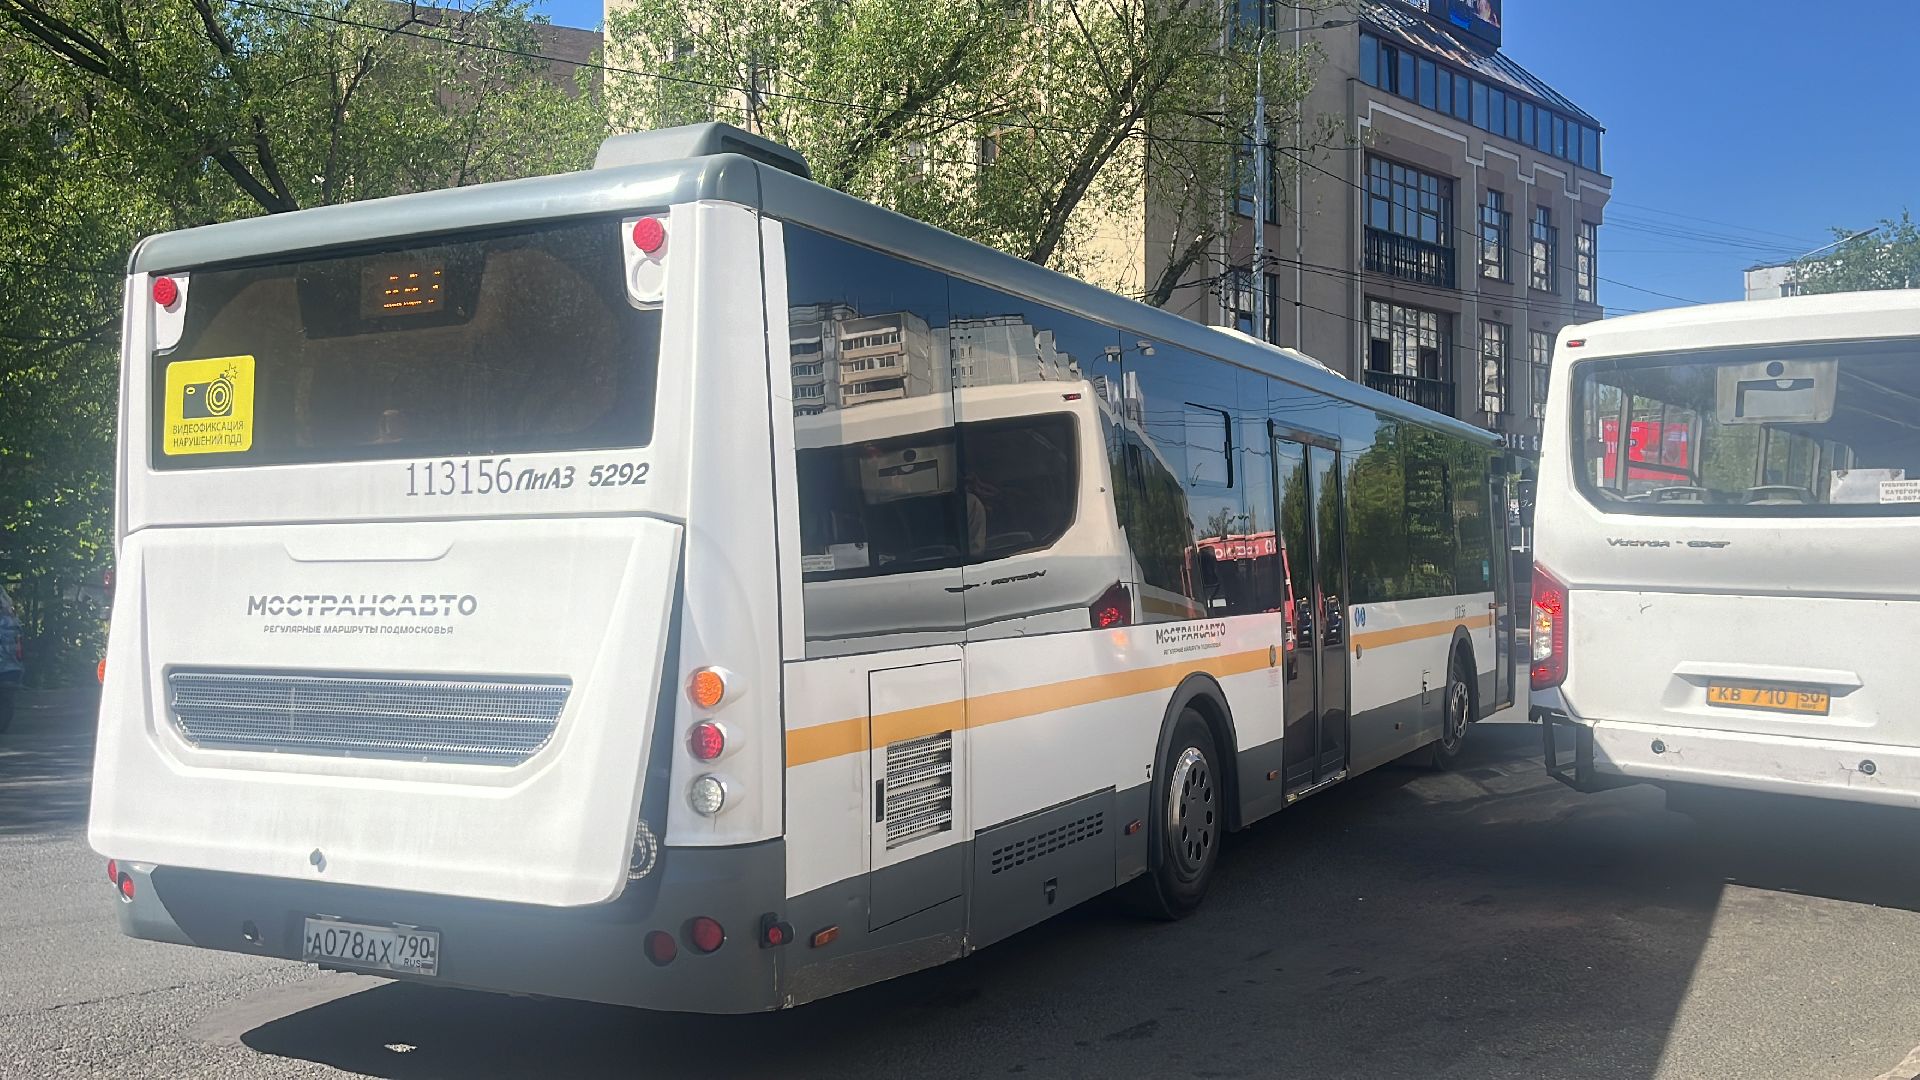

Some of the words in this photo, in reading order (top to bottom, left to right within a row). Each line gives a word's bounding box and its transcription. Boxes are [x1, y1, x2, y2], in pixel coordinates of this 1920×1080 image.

[173, 421, 243, 435] ВИДЕОФИКСАЦИЯ
[173, 434, 223, 447] НАРУШЕНИЙ
[225, 434, 242, 446] ПДД
[406, 458, 513, 496] 113156
[516, 465, 576, 491] ЛиАЗ
[588, 462, 650, 487] 5292
[247, 594, 478, 617] МОСТРАНСАВТО
[263, 625, 321, 634] РЕГУЛЯРНЫЕ
[324, 625, 378, 634] МАРШРУТЫ
[380, 625, 453, 635] ПОДМОСКОВЬЯ
[398, 935, 430, 959] 790
[403, 957, 421, 968] RUS
